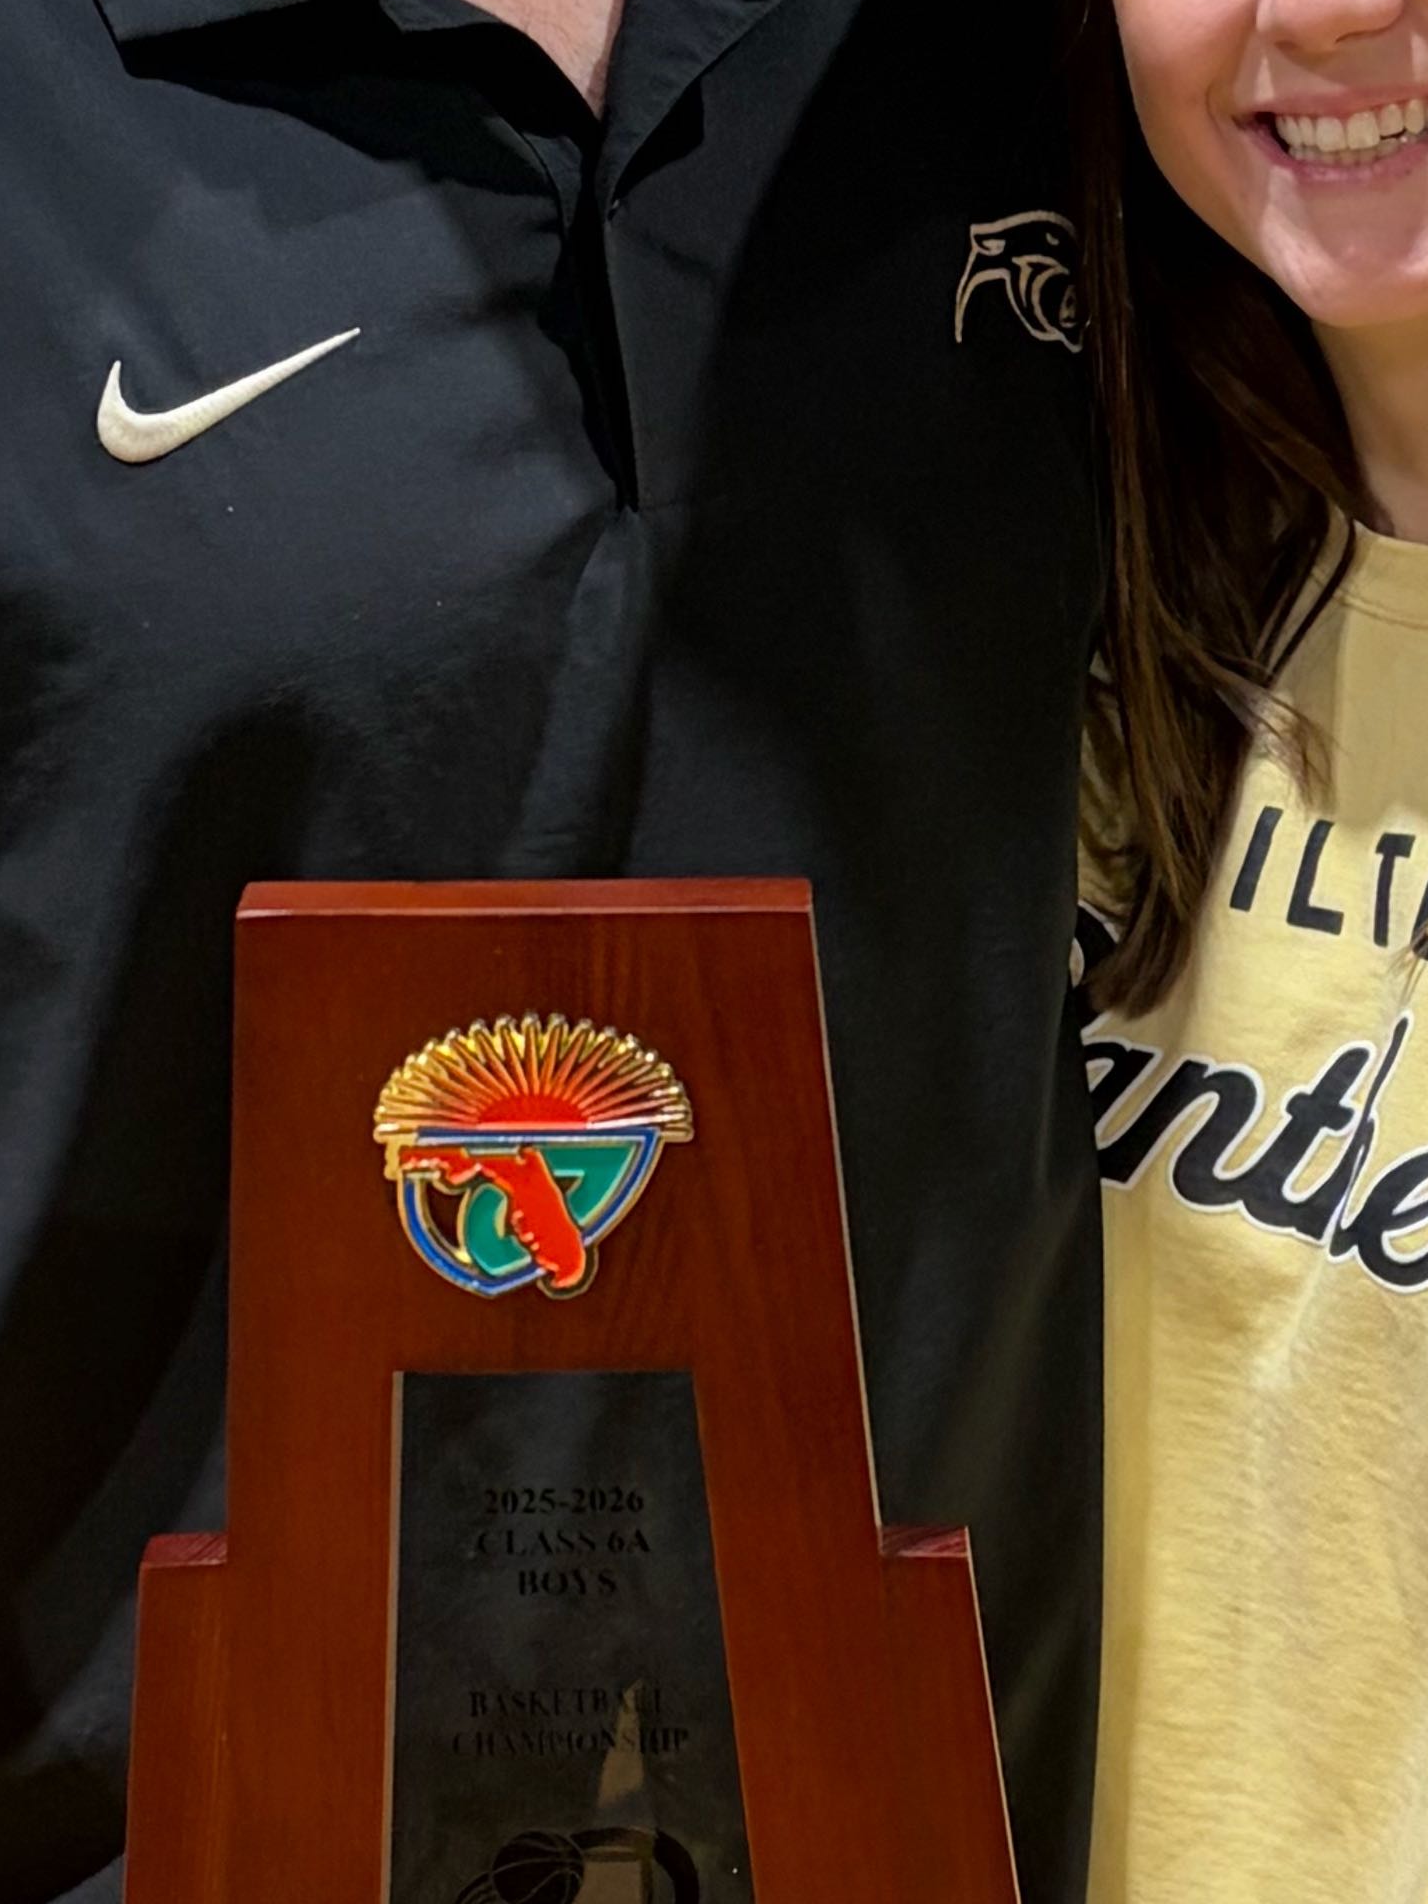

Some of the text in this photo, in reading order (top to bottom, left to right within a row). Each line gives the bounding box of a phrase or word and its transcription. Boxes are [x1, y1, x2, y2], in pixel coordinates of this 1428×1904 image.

[483, 1485, 645, 1516] 2025-2026
[476, 1528, 652, 1556] CLASS 6A
[517, 1568, 619, 1597] BOYS
